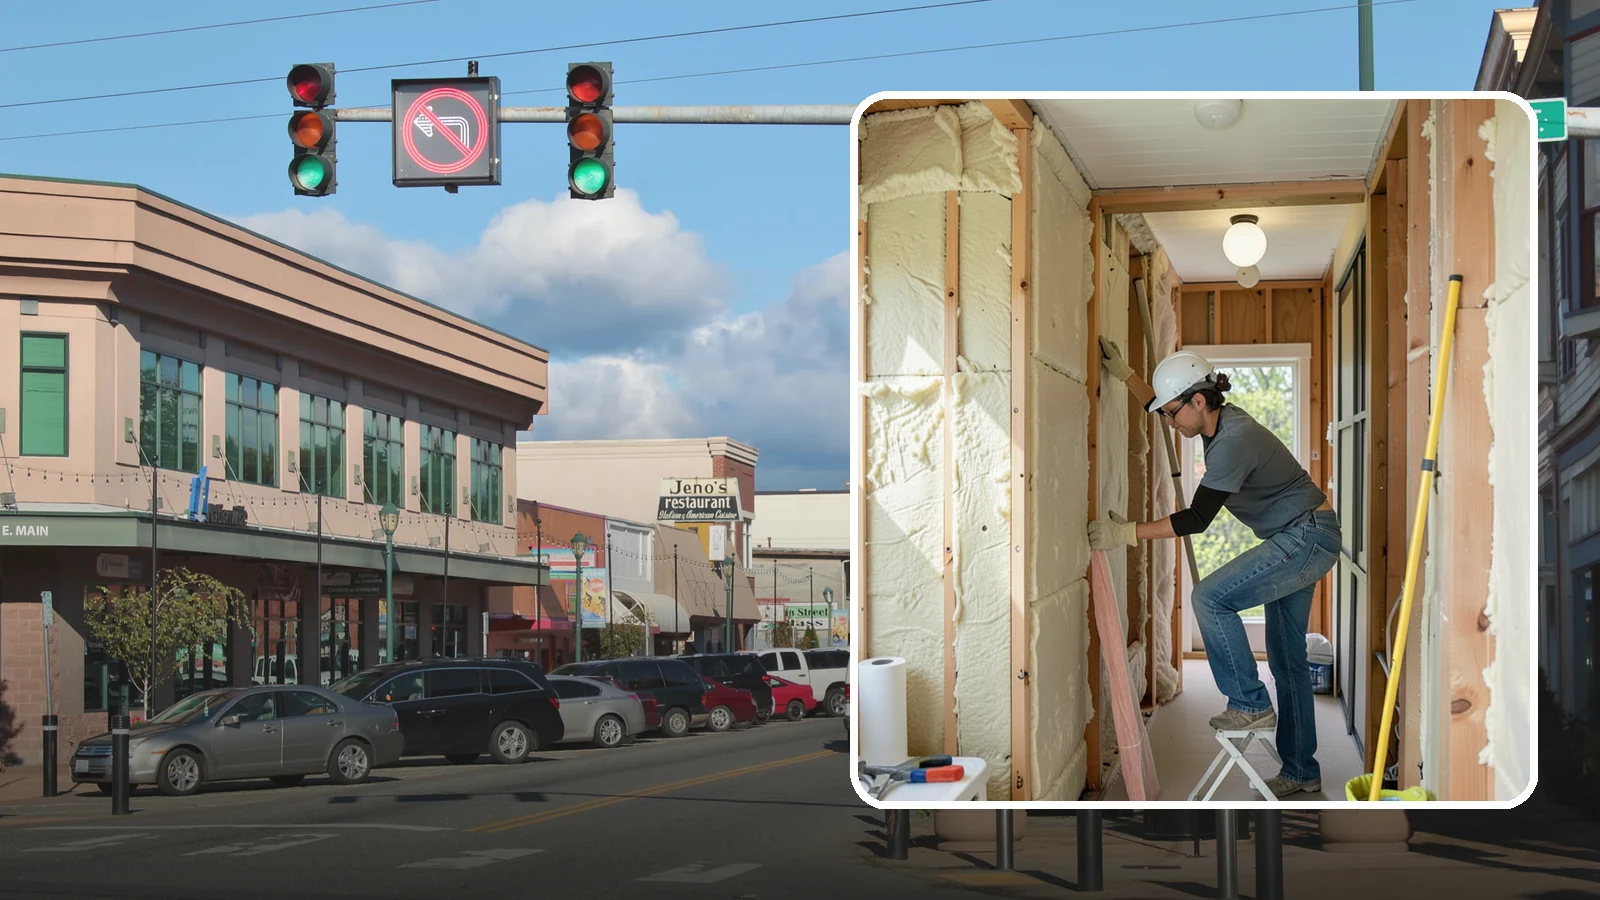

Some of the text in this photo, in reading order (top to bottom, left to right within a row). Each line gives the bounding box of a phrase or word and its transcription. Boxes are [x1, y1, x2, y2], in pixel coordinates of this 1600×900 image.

[670, 480, 727, 494] Jeno's
[665, 497, 731, 509] restaurant
[658, 510, 681, 519] Italian
[686, 509, 714, 519] American
[715, 509, 737, 519] Cuisine
[2, 525, 49, 536] E. MAIN
[797, 607, 828, 617] Street
